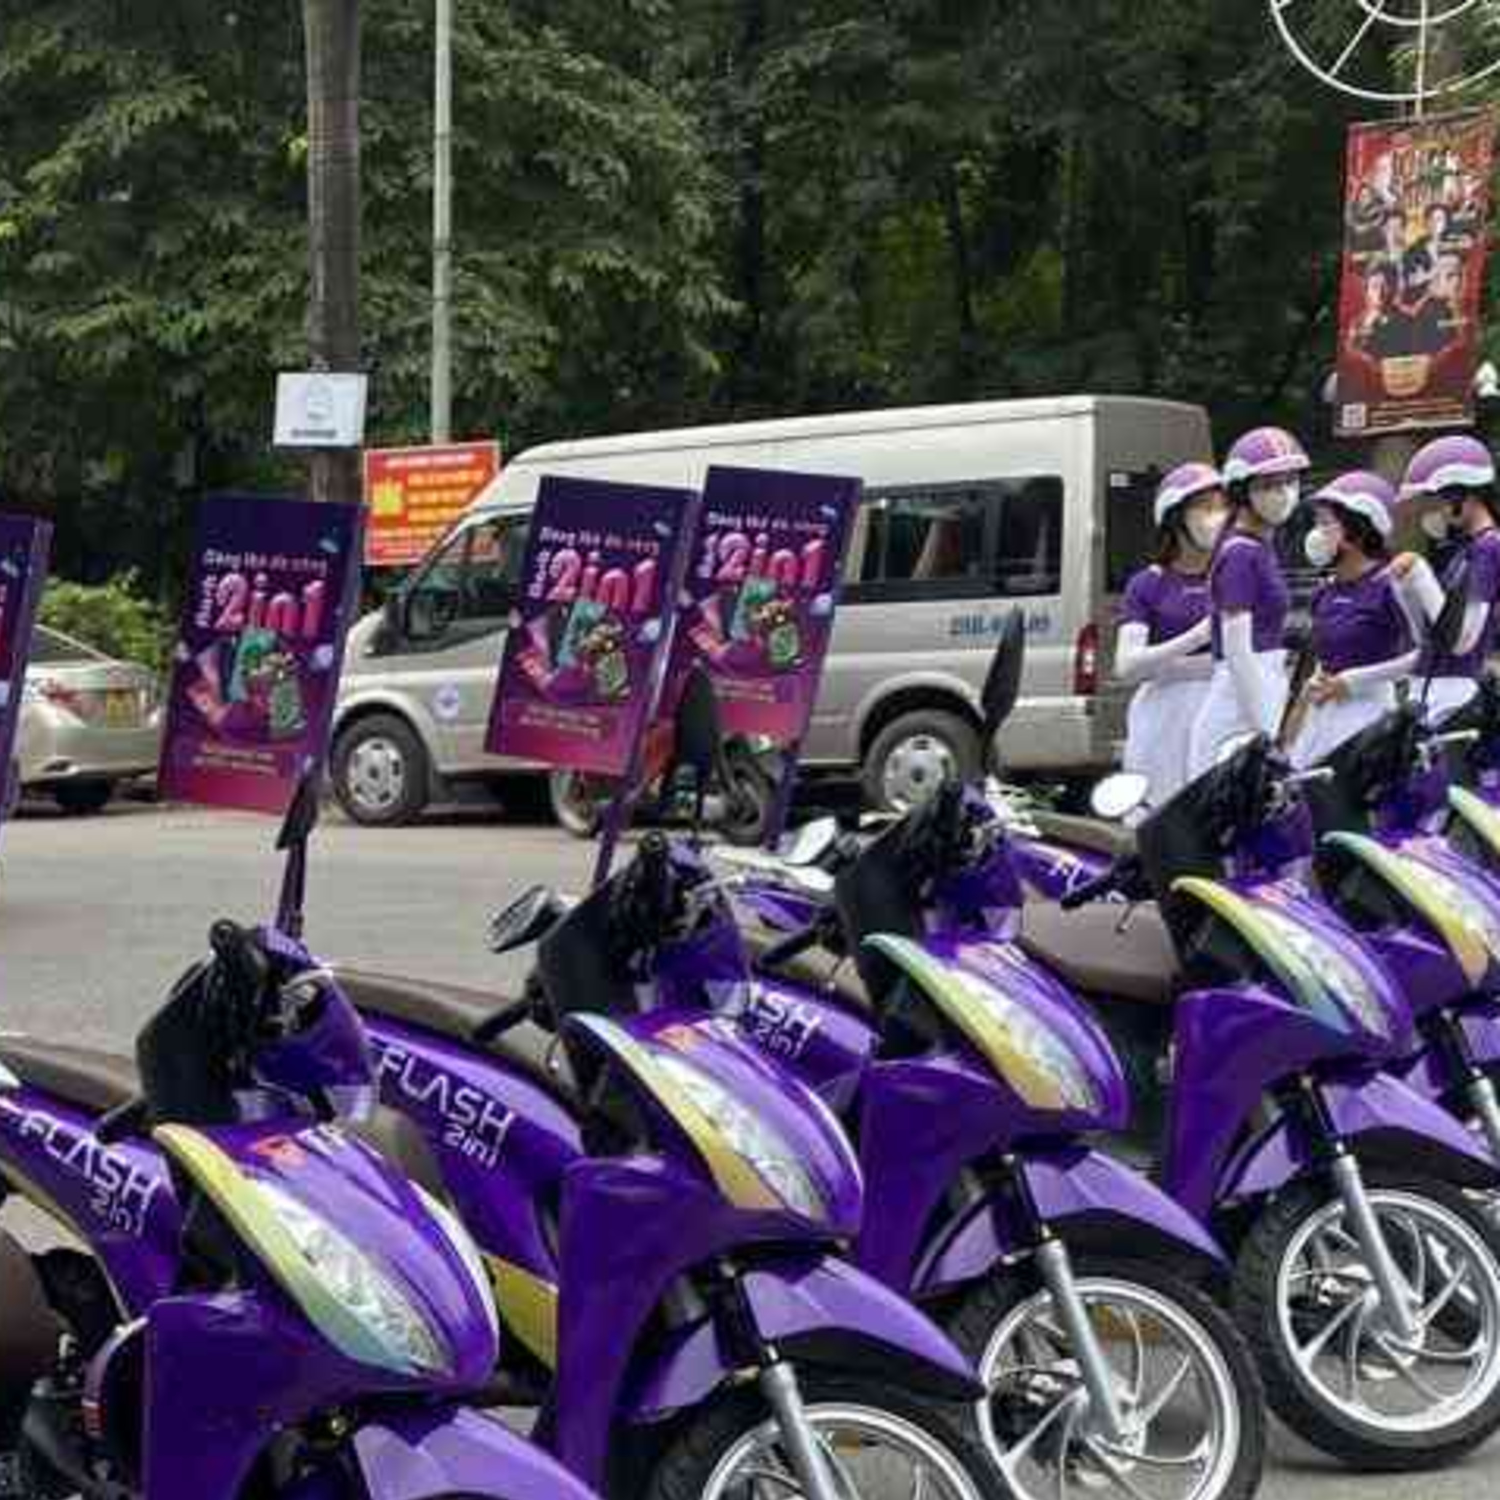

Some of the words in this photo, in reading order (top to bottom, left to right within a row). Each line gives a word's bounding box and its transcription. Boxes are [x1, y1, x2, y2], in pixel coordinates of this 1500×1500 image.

[546, 548, 659, 613] 2in1
[717, 531, 828, 588] 2in1
[214, 572, 325, 637] 2in1
[376, 1047, 516, 1147] FLASH
[17, 1108, 162, 1211] FLASH
[445, 1121, 499, 1170] 2in1
